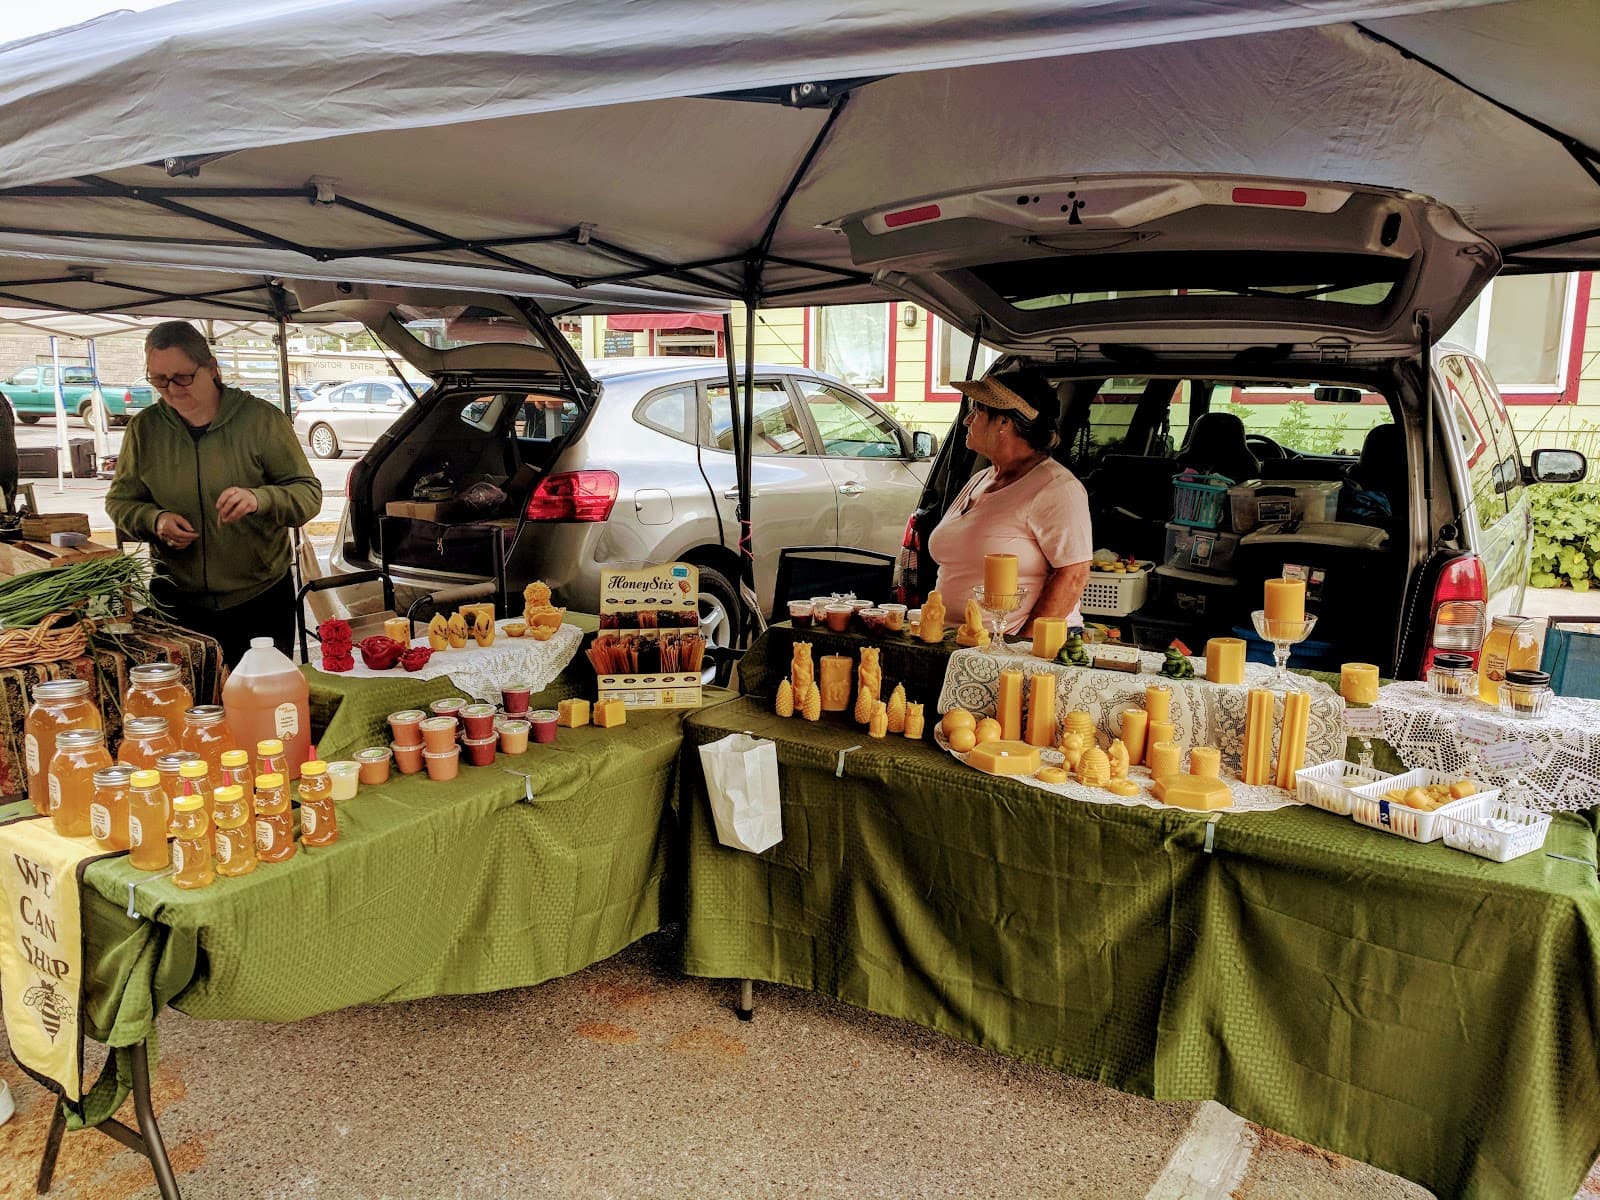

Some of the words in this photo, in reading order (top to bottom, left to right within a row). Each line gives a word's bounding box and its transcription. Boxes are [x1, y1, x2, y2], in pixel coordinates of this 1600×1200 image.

[312, 361, 342, 369] VISITOR
[607, 575, 675, 592] HoneyStix
[14, 853, 51, 899] WE
[19, 895, 58, 944] CAN
[21, 935, 70, 982] SHIP
